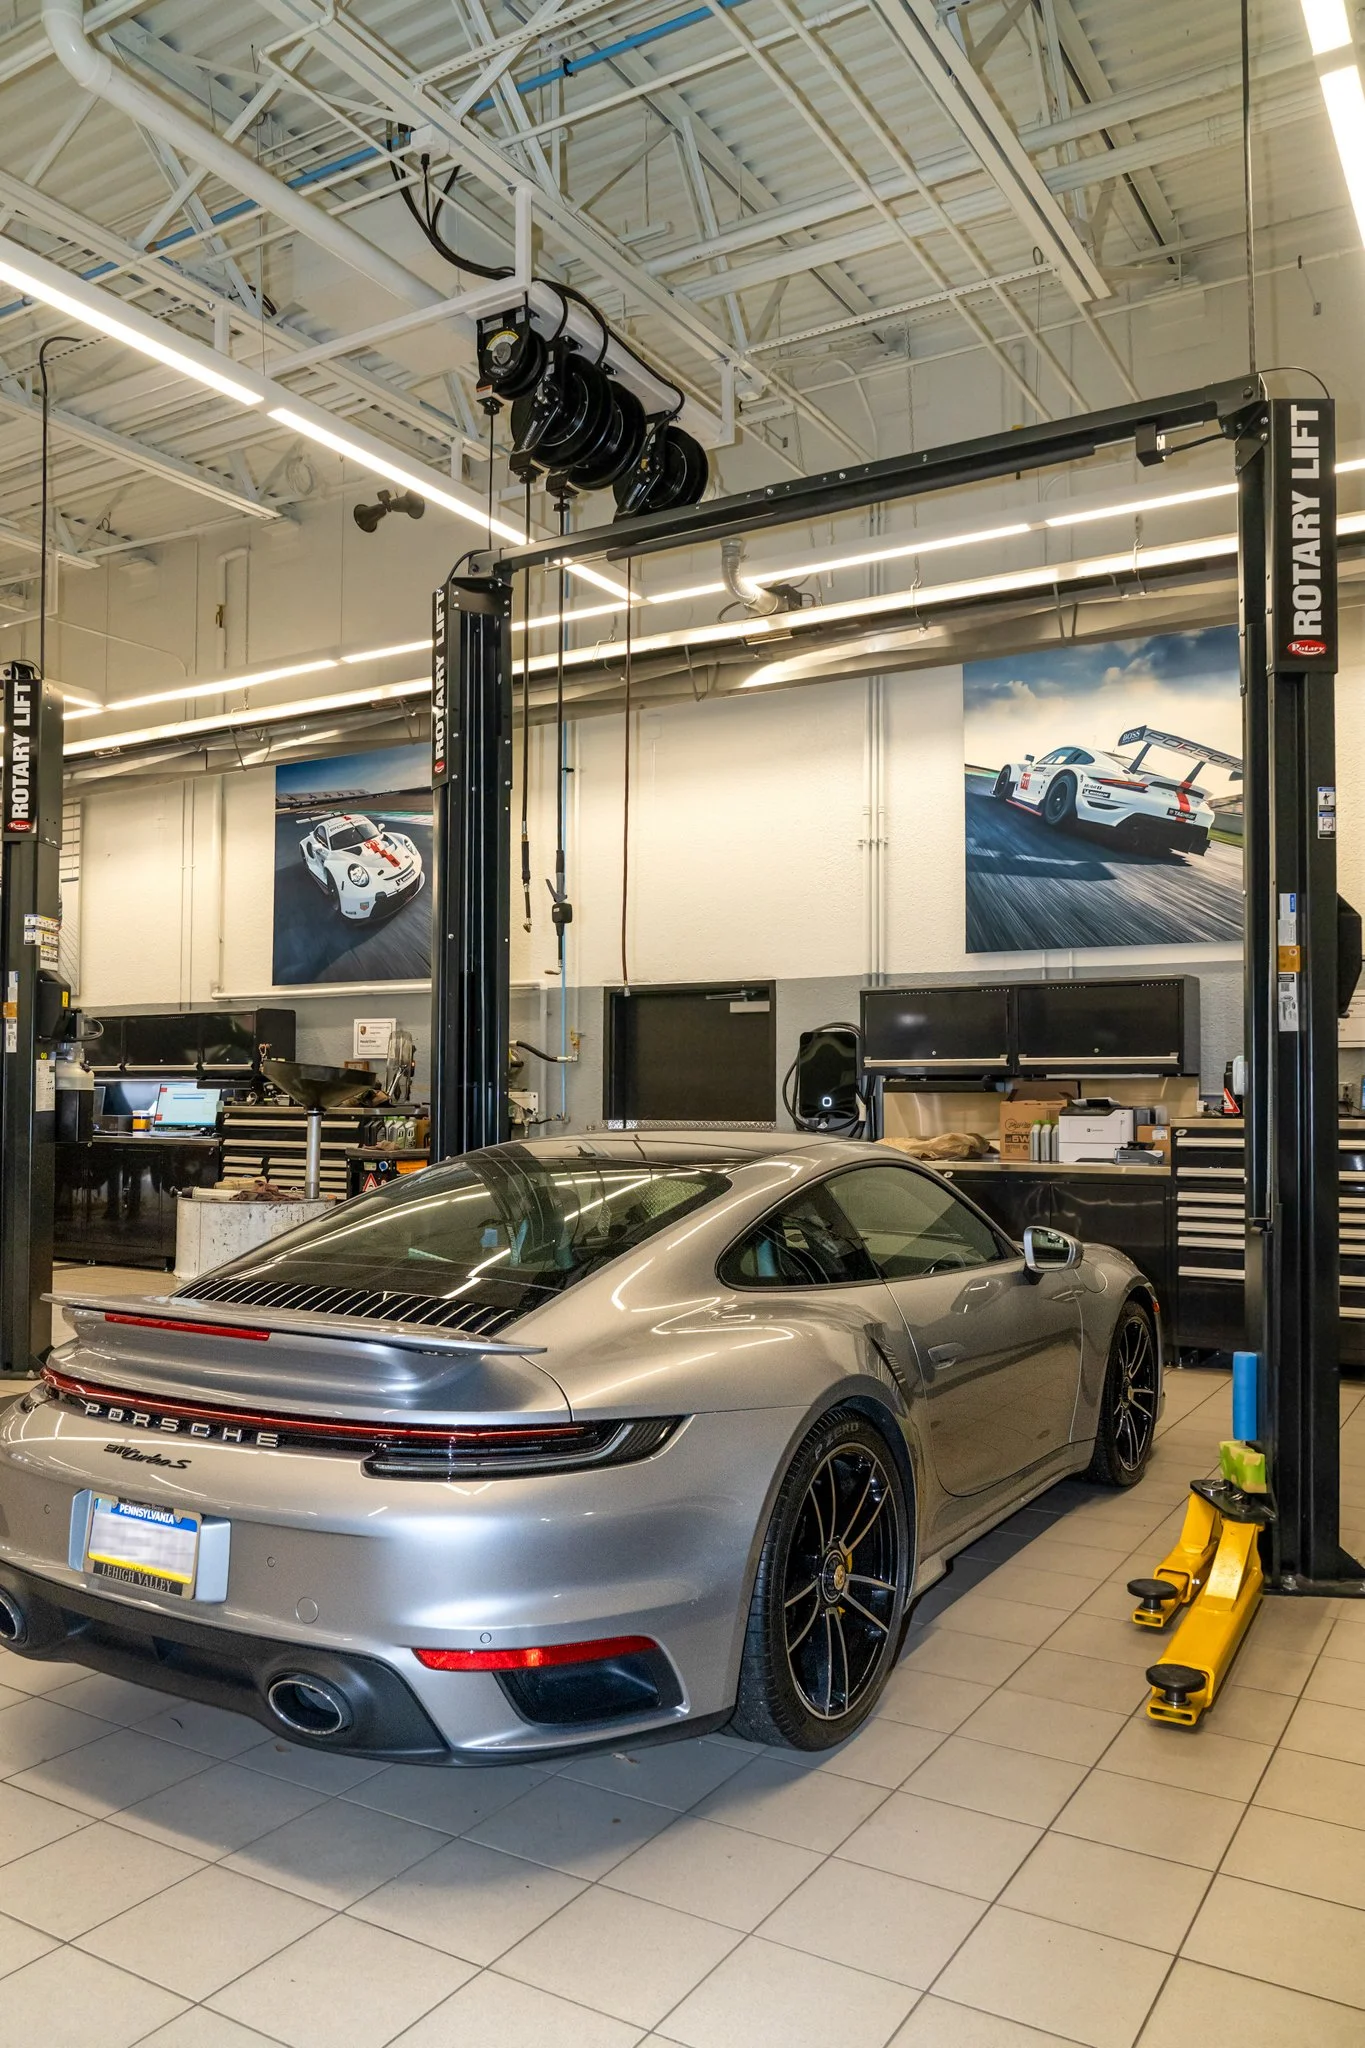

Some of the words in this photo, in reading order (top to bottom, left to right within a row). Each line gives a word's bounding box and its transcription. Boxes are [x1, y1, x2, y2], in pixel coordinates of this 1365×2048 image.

[1290, 404, 1319, 479] LIFT
[1291, 490, 1322, 635] ROTARY
[435, 592, 445, 647] LIFT
[1291, 643, 1326, 655] Rotary
[13, 682, 31, 727] LIFT
[435, 655, 445, 760] ROTARY
[11, 732, 30, 819] ROTARY
[85, 1402, 280, 1448] PORSCHE
[104, 1443, 130, 1454] 911
[168, 1459, 192, 1470] S
[815, 1443, 823, 1460] P
[119, 1503, 175, 1525] PENNSYLVANIA
[101, 1563, 135, 1584] LEHIGH
[138, 1571, 173, 1593] VALLEY
